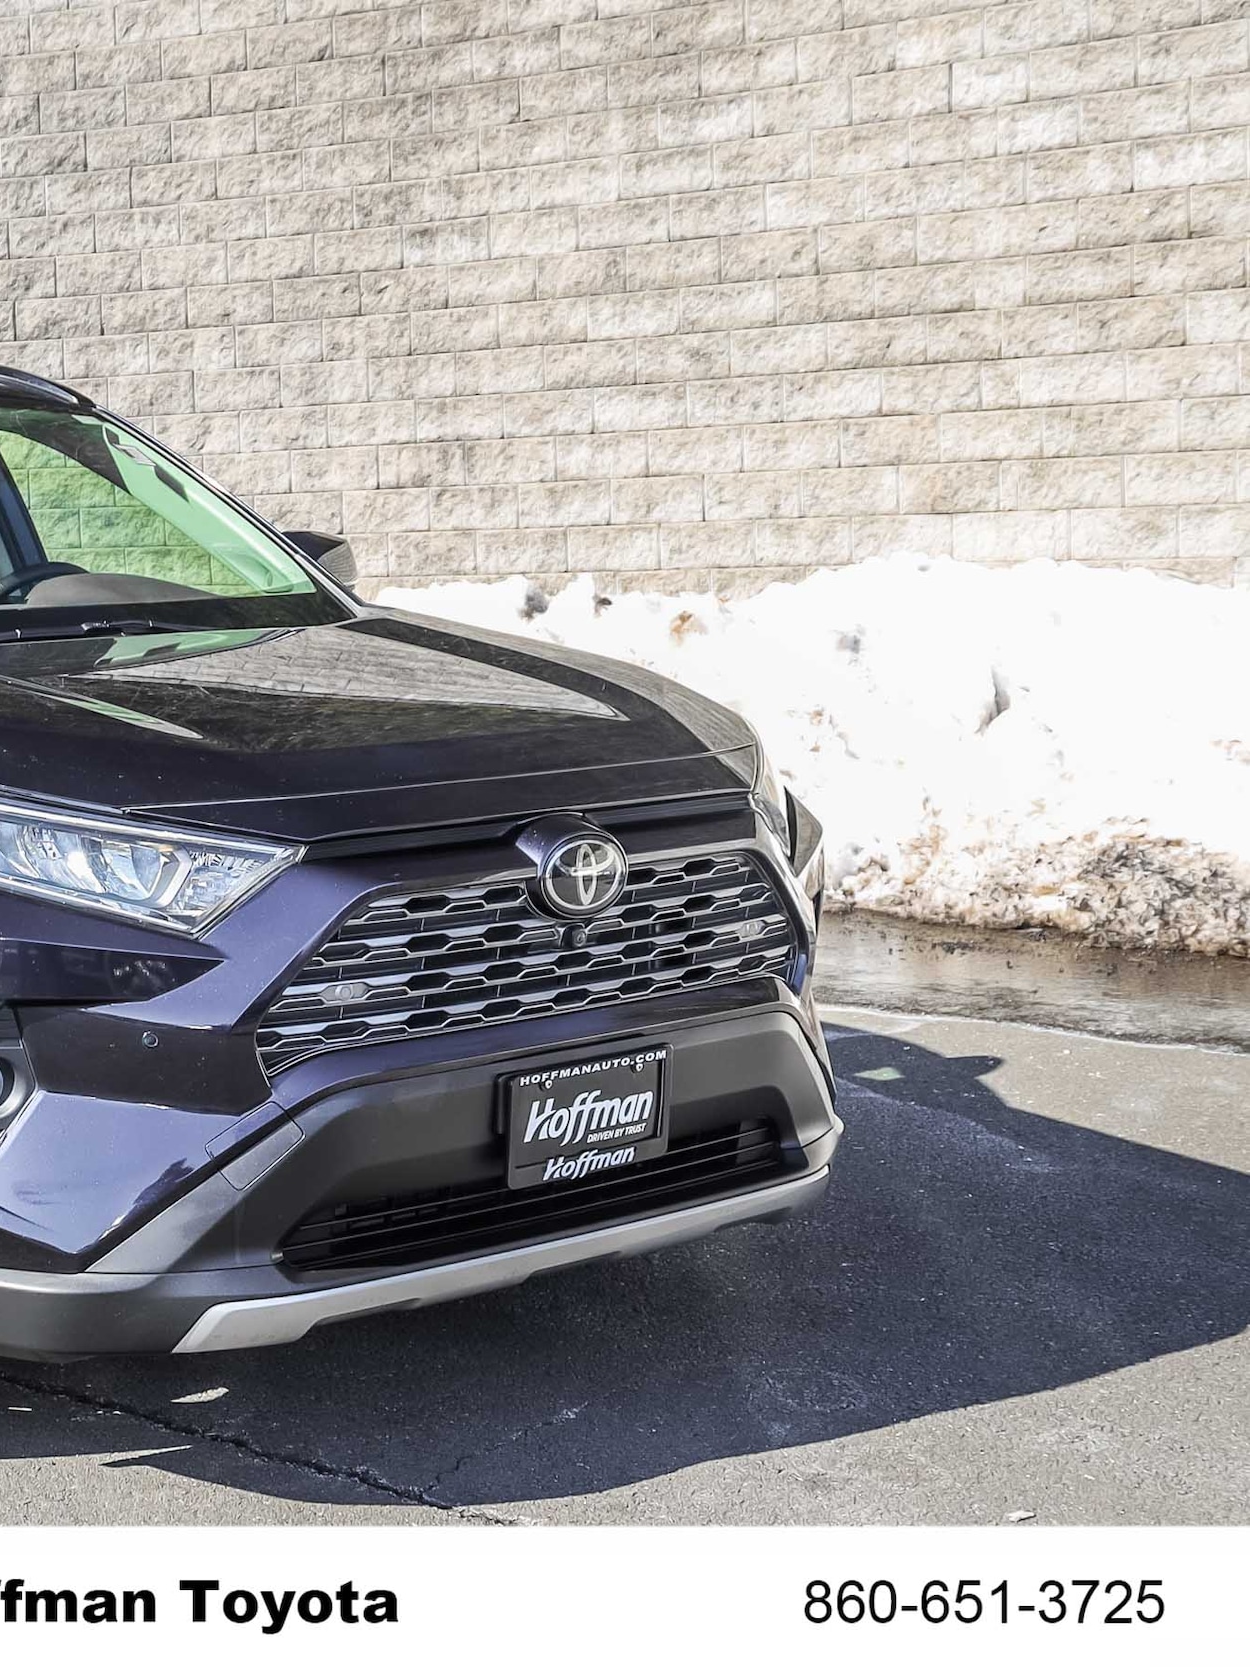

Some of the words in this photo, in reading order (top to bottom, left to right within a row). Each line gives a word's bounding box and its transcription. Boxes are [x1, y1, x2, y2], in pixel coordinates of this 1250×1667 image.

[519, 1049, 667, 1087] HOFFMANAUTO.COM
[523, 1089, 654, 1147] Hoffman
[586, 1129, 614, 1144] DRIVEN
[614, 1127, 624, 1138] BY
[625, 1122, 647, 1136] TRUST
[542, 1146, 635, 1181] Hoffman
